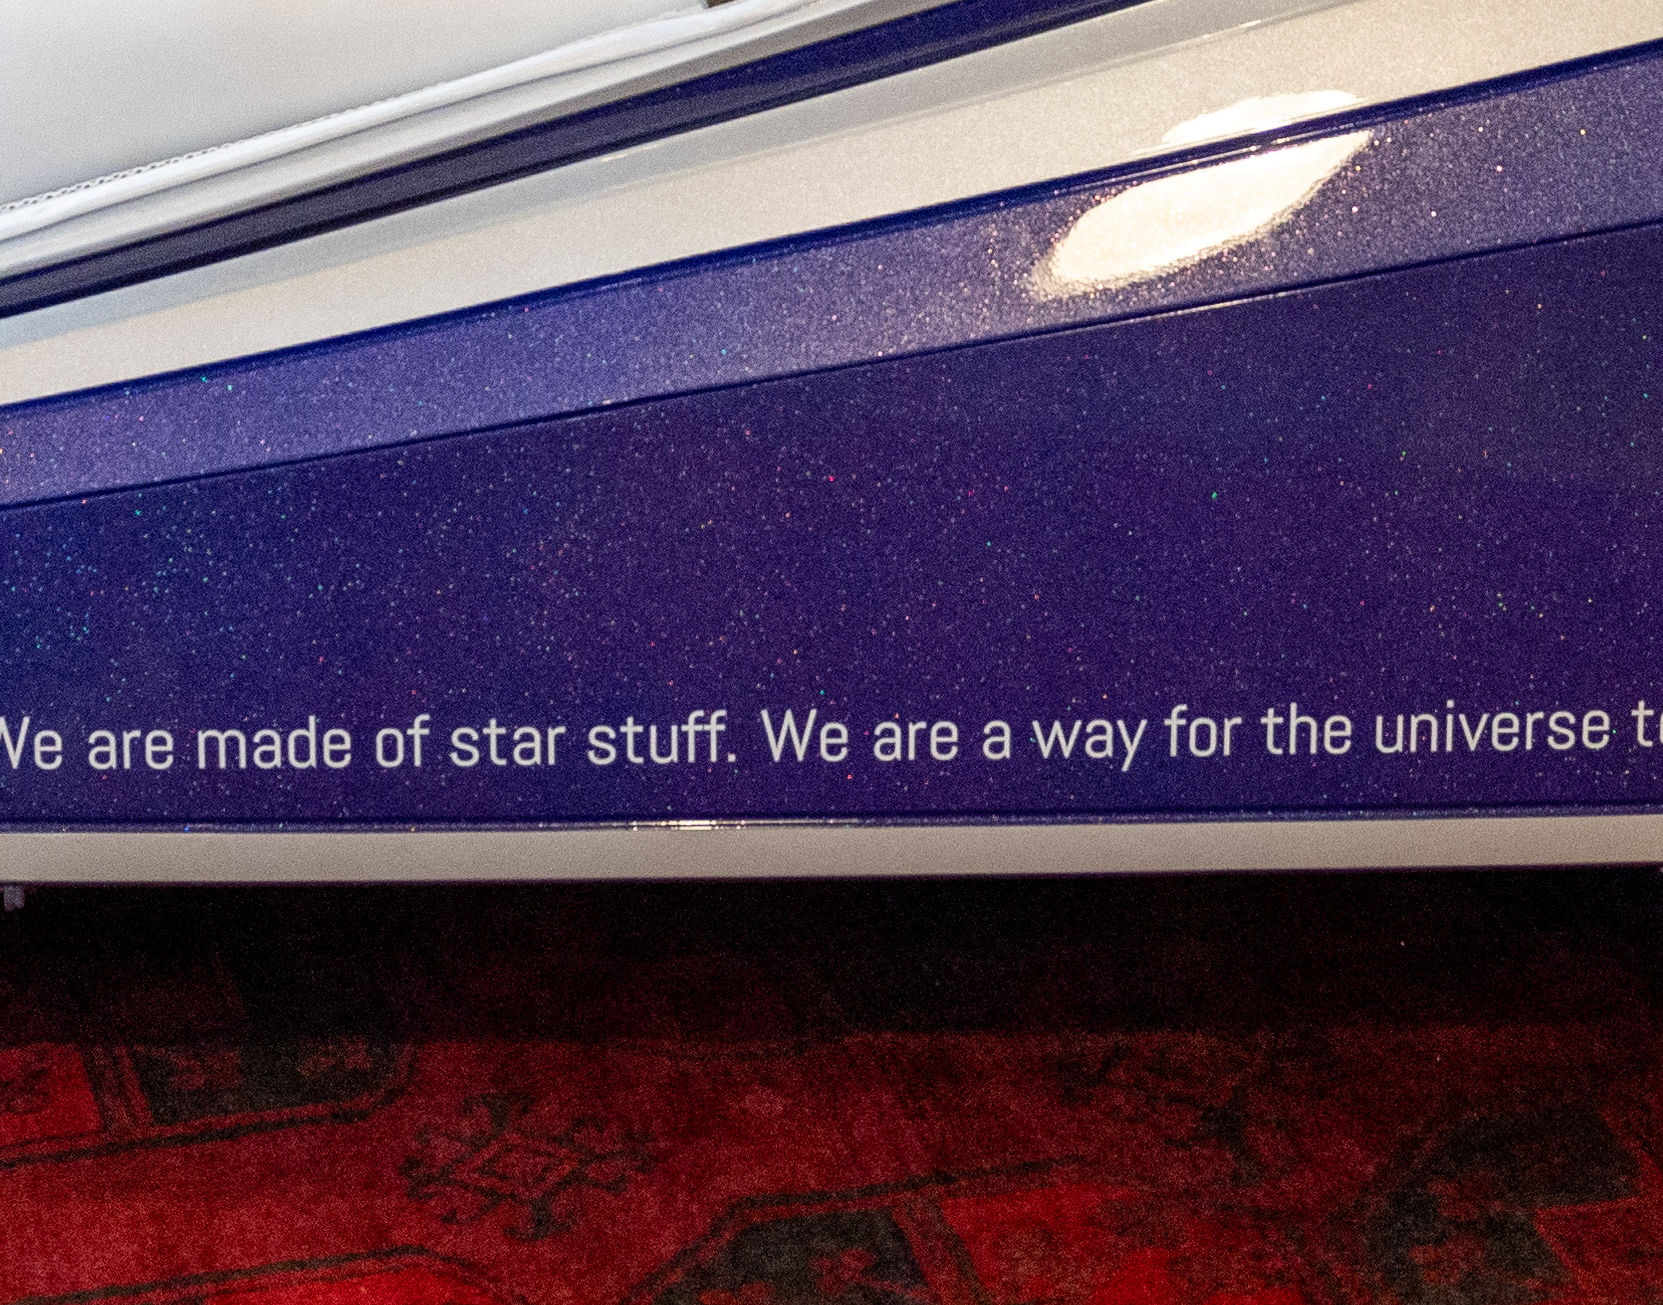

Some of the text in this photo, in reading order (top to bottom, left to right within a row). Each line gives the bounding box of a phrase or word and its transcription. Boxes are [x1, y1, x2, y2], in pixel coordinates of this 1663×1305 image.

[88, 729, 174, 770] are
[197, 714, 352, 770] made
[375, 713, 431, 769] of
[448, 717, 567, 768] star
[587, 709, 737, 766] stuff.
[760, 708, 850, 764] We
[873, 720, 959, 763] are
[982, 720, 1011, 761] a
[1032, 719, 1148, 772] way
[1163, 703, 1243, 758] for
[1260, 702, 1352, 756] the
[1375, 696, 1611, 755] universe
